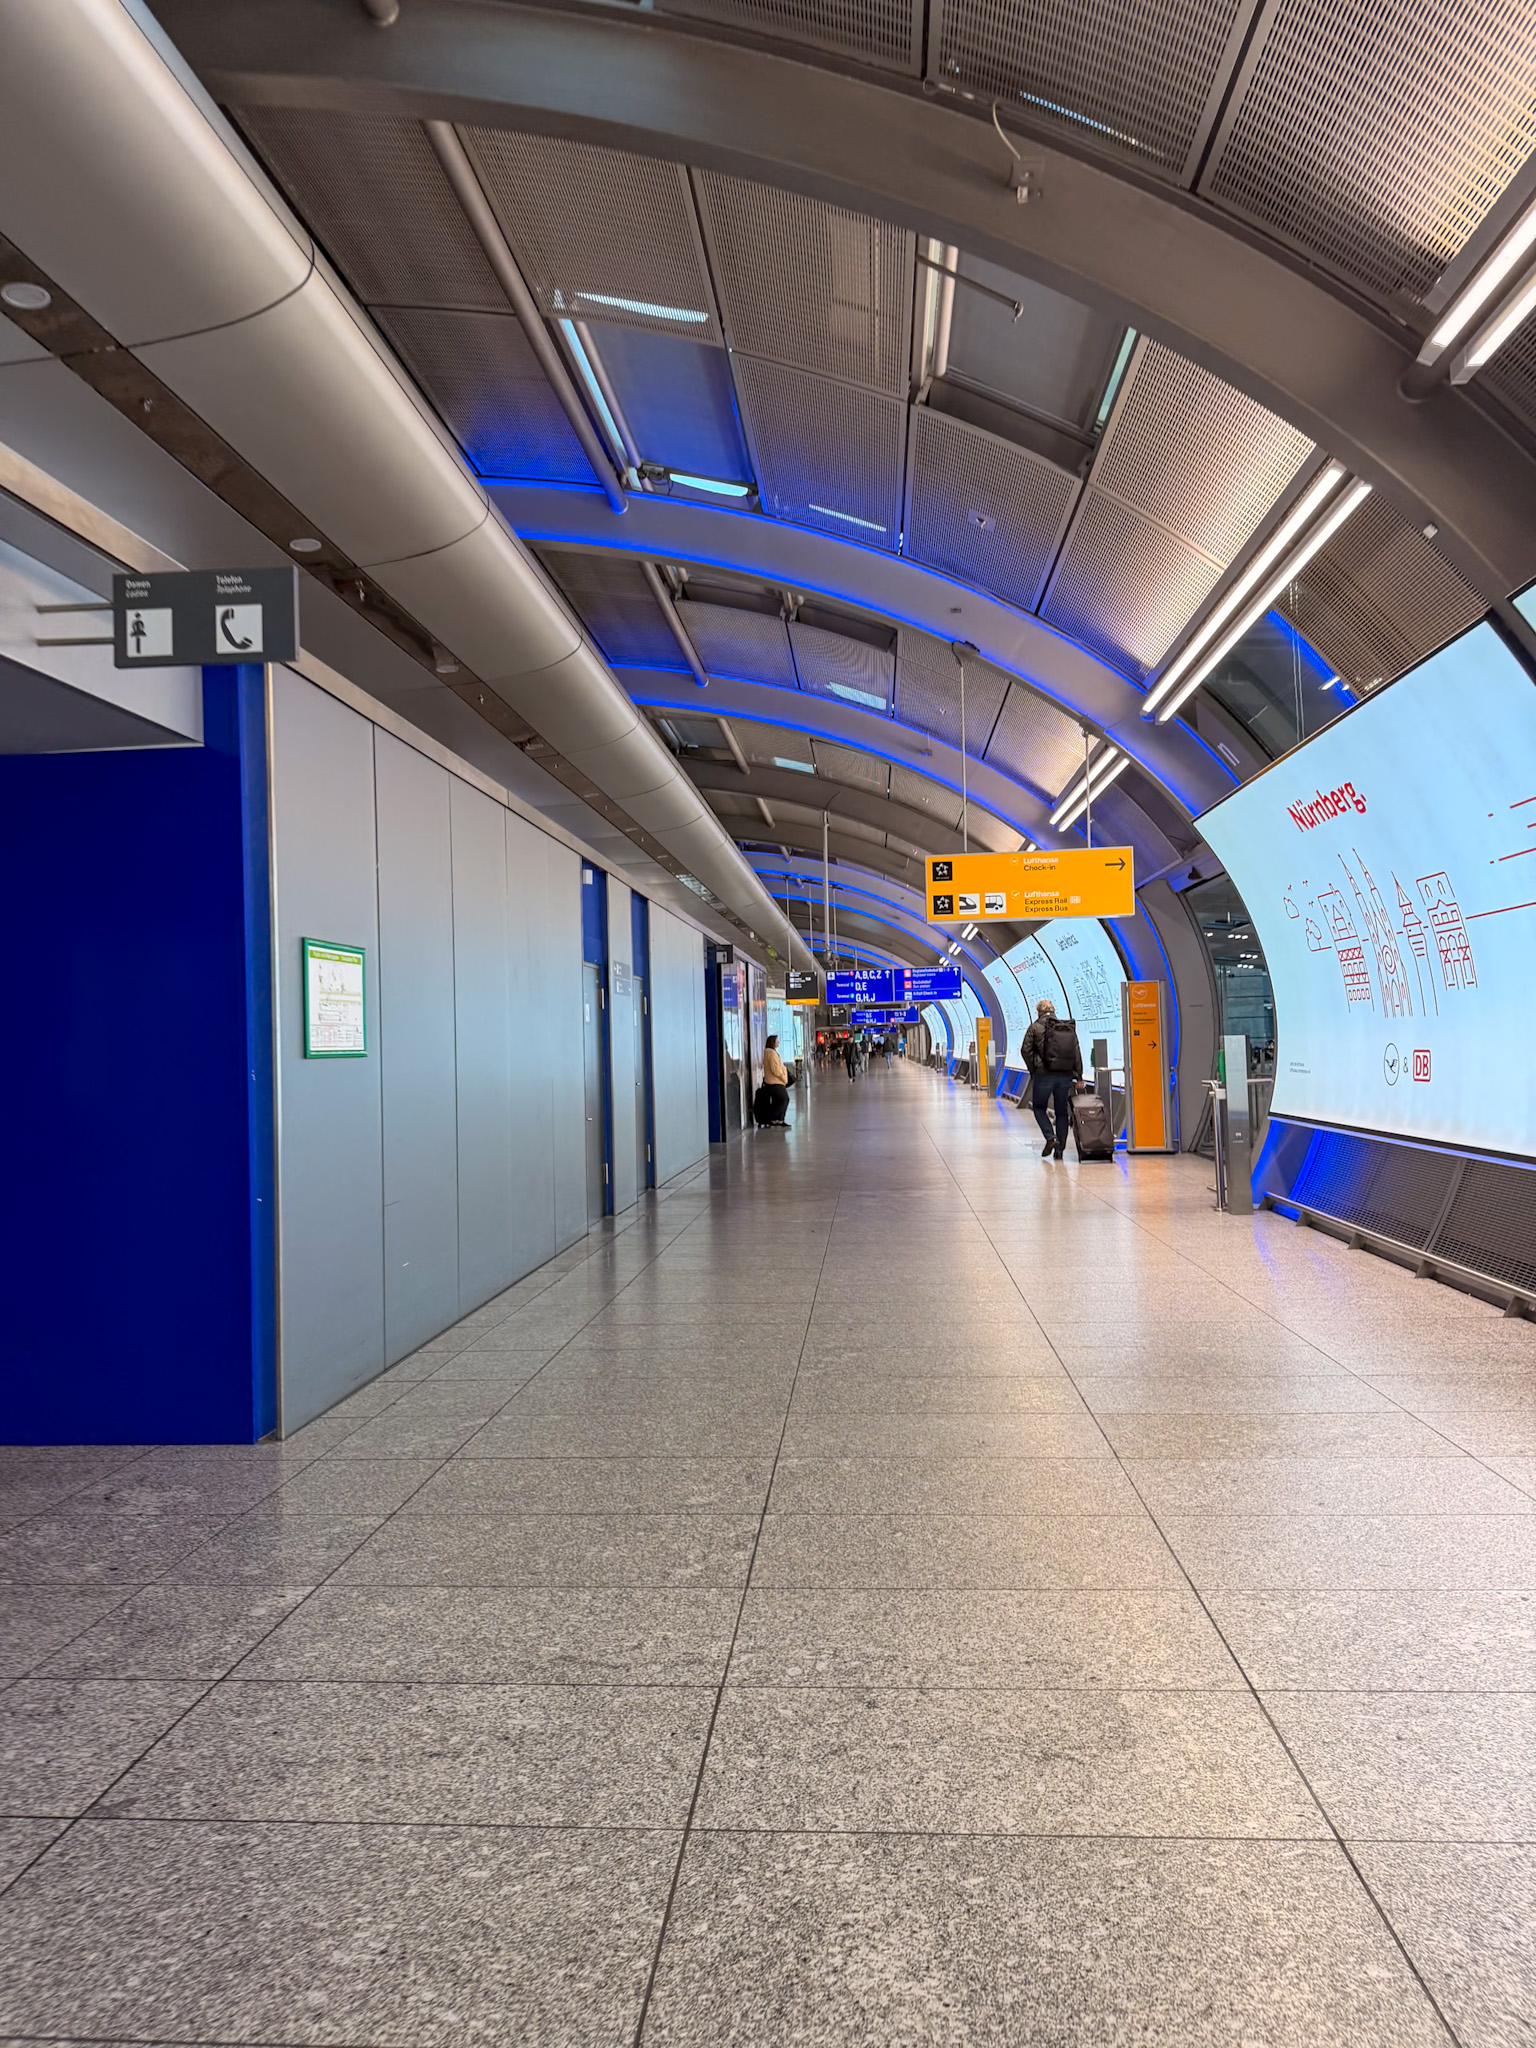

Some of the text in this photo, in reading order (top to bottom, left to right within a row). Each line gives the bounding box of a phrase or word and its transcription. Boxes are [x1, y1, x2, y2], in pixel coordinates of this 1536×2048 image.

[125, 579, 151, 589] Damen
[216, 575, 243, 585] Telefon
[1024, 898, 1053, 906] Express
[855, 970, 882, 980] A,B,C,Z
[855, 981, 867, 991] D,E
[855, 993, 876, 1003] G,H,J
[1403, 1055, 1429, 1077] & DB
